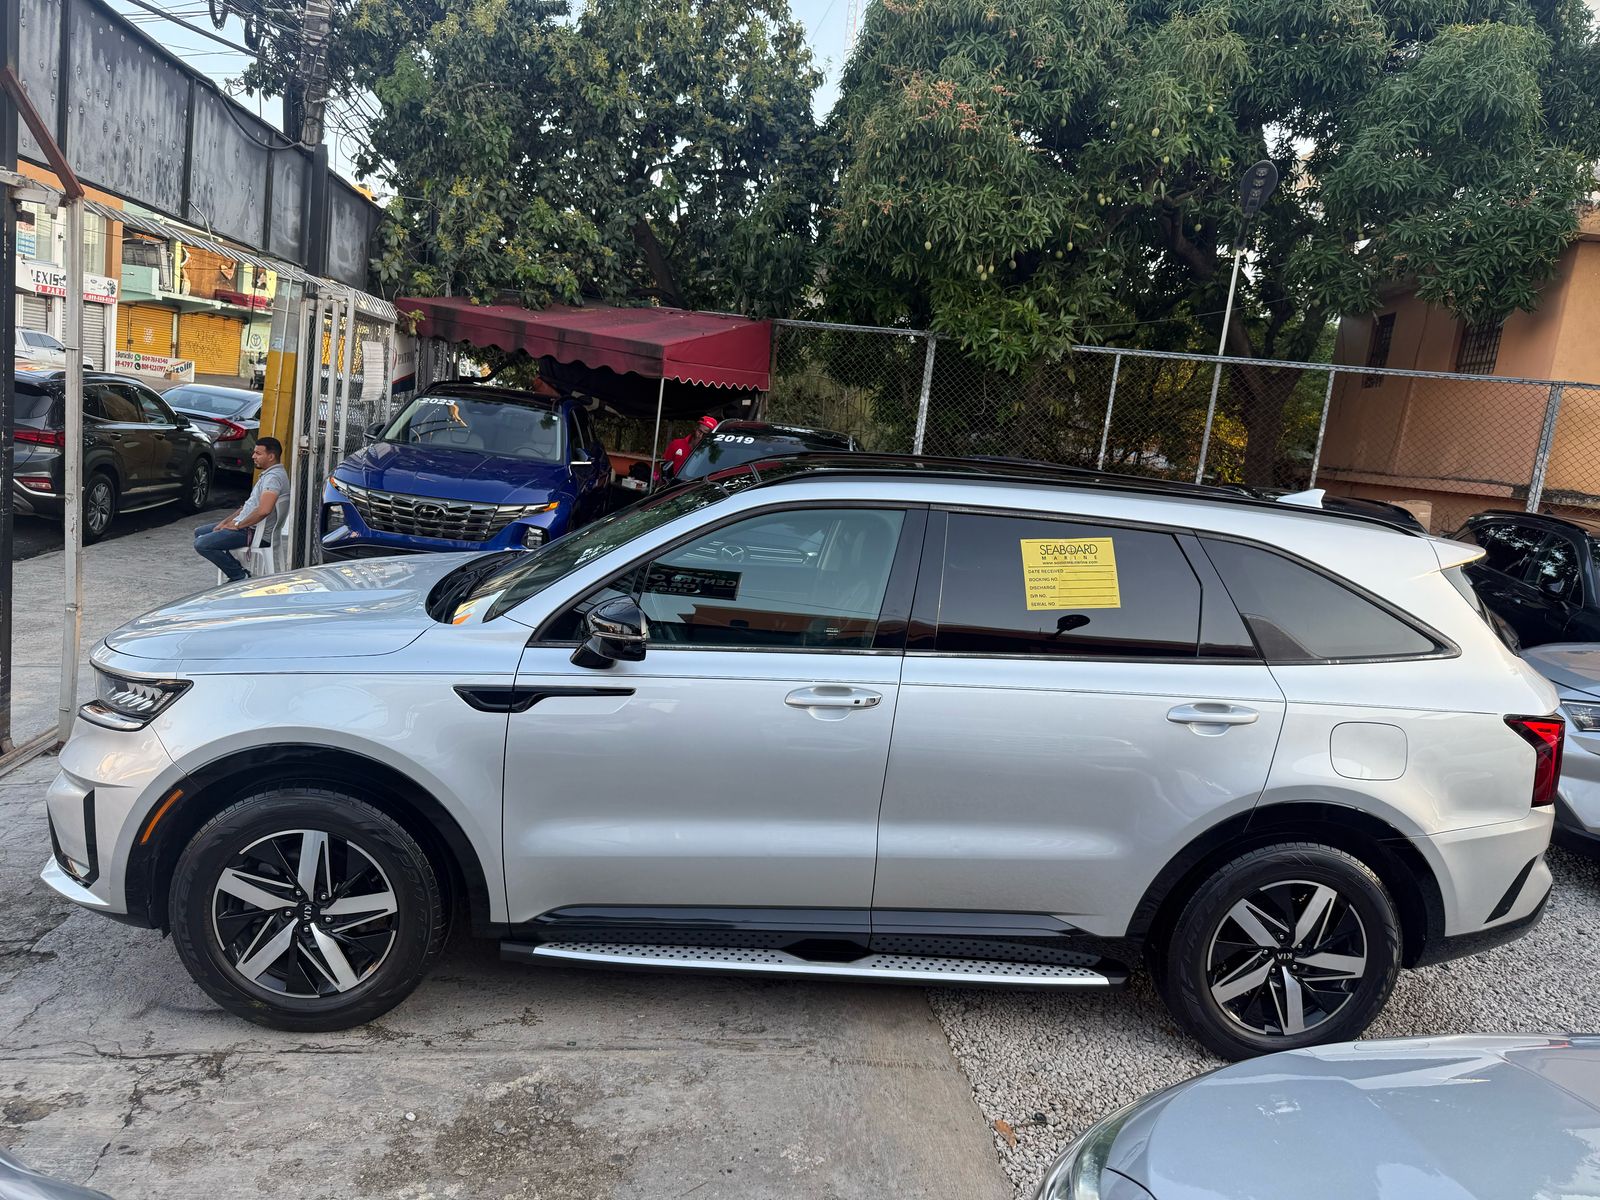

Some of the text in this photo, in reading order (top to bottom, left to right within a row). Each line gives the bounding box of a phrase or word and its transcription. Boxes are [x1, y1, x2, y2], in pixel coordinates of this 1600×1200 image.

[420, 397, 456, 406] 2023
[713, 434, 755, 445] 2019
[1040, 544, 1098, 556] SEABOARD
[303, 904, 313, 921] KIA
[1276, 952, 1293, 960] KIA
